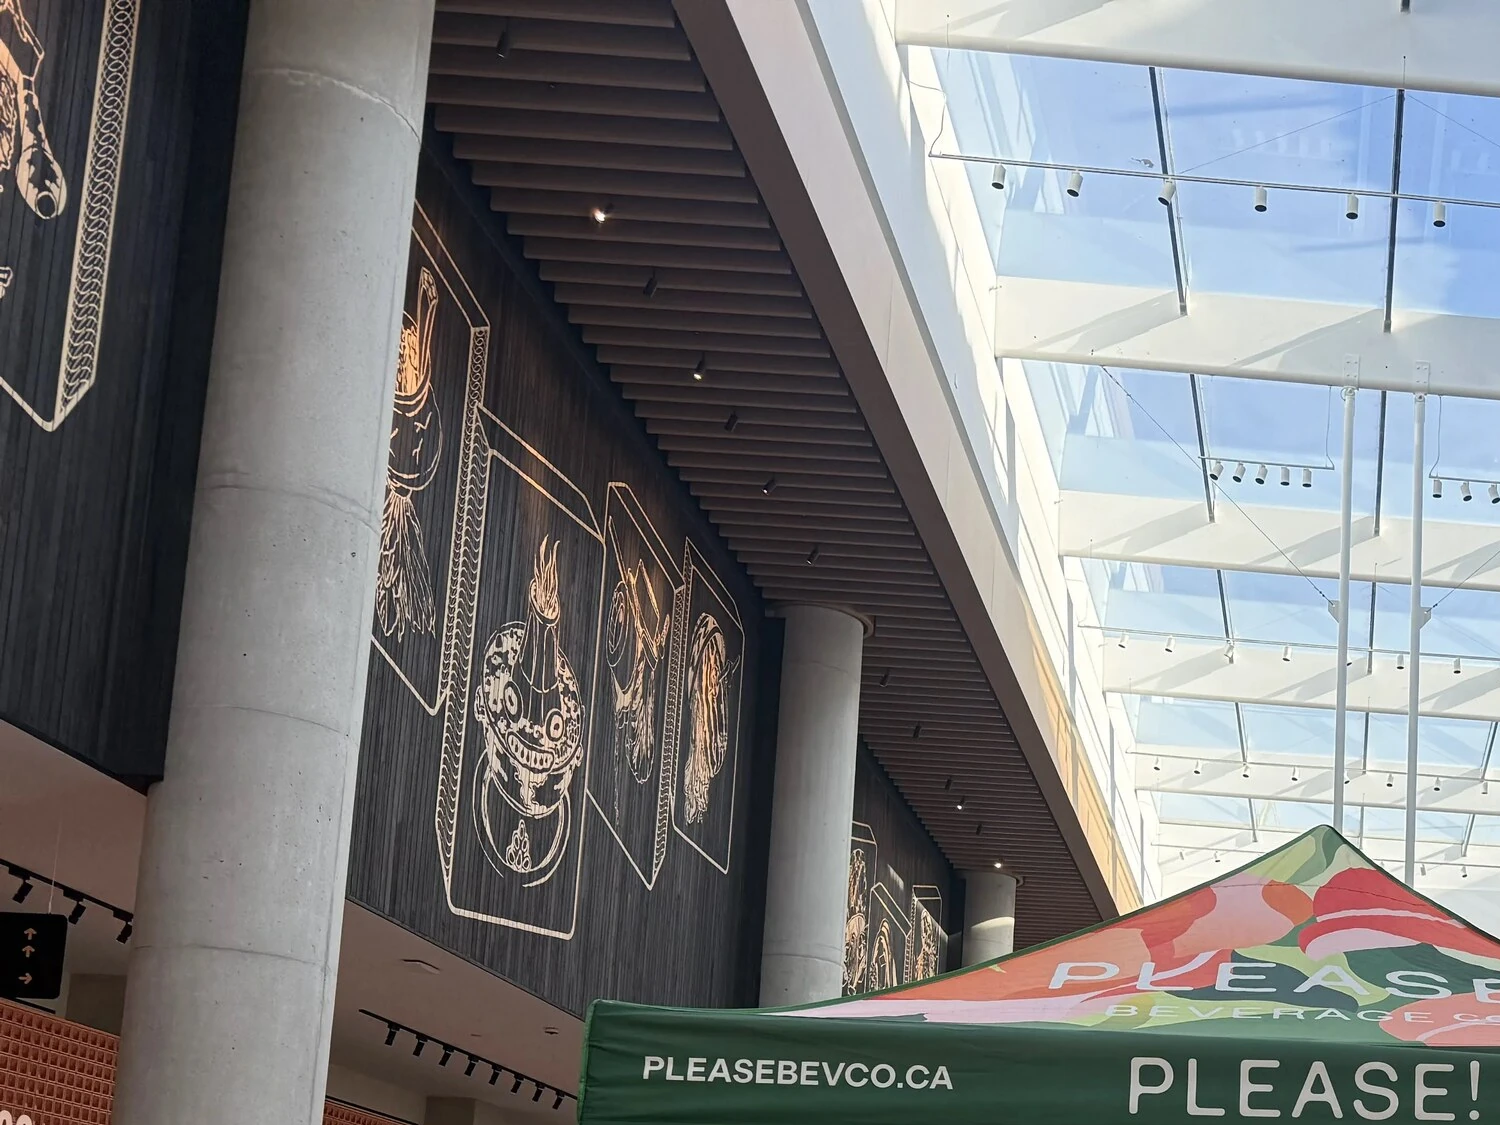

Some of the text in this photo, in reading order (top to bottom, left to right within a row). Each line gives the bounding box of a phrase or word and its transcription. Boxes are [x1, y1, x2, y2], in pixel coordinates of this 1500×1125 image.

[1105, 1004, 1434, 1023] BEVERAGE
[642, 1056, 954, 1090] PLEASEBEVCO.CA
[1128, 1056, 1481, 1121] PLEASE!
